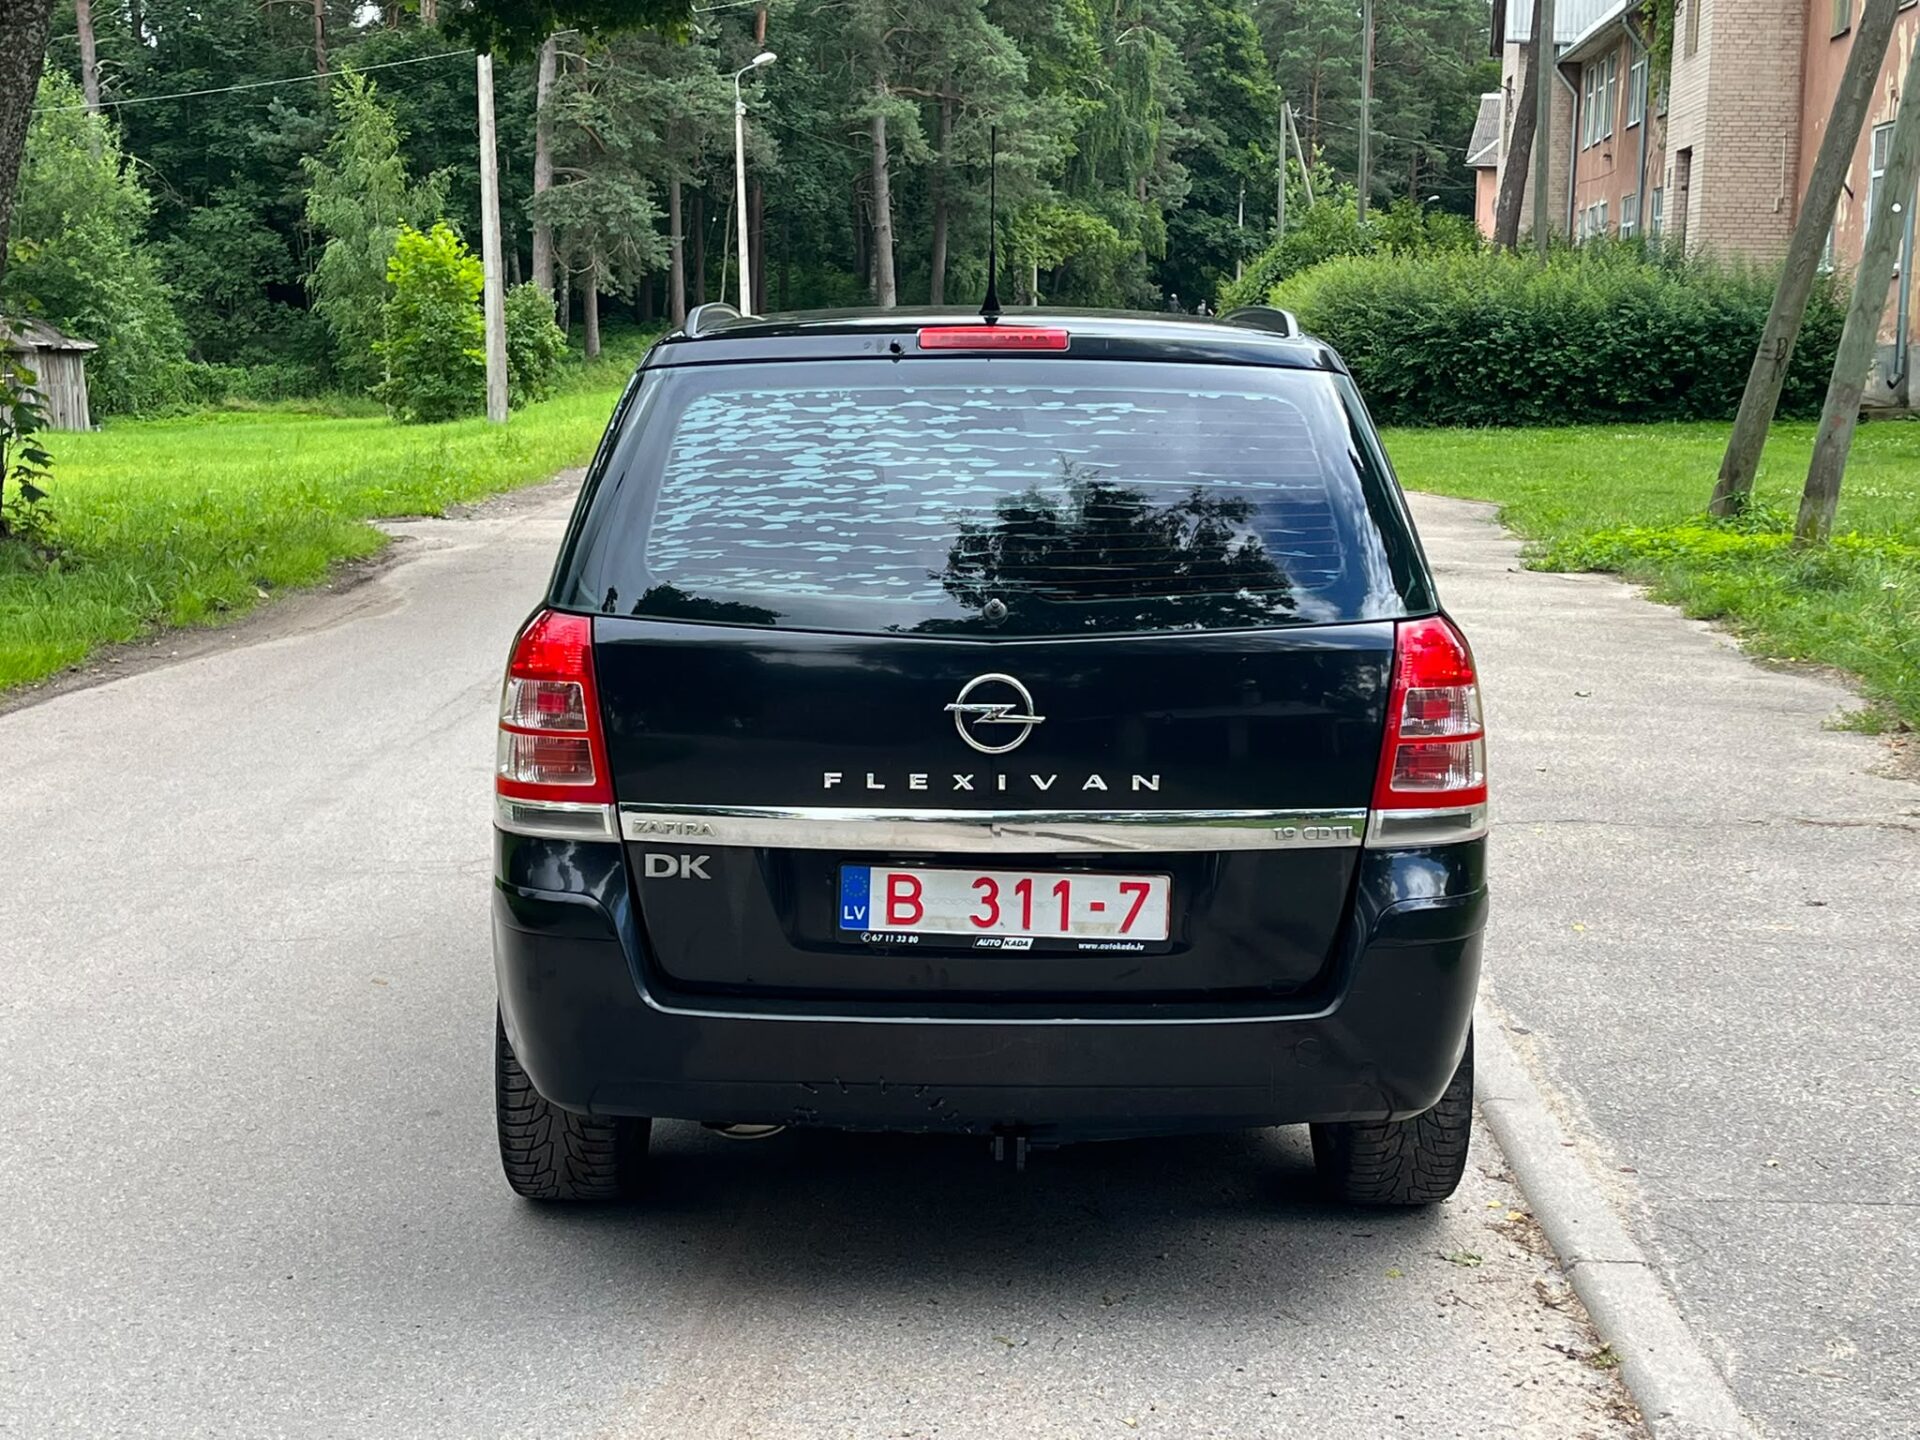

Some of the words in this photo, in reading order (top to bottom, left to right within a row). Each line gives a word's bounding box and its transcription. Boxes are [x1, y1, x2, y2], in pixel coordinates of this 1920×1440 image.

[823, 772, 1160, 790] FLEXIVAN
[632, 820, 716, 836] ZAFIRA
[1303, 825, 1353, 840] CDTI
[644, 853, 711, 879] DK
[886, 873, 924, 926] B
[970, 876, 1151, 933] 311-7
[843, 905, 866, 920] LV
[871, 933, 883, 942] 67
[885, 934, 894, 942] 11
[896, 935, 906, 943] 33
[976, 938, 1001, 947] AUTO
[1003, 939, 1030, 948] KADA
[1078, 942, 1145, 951] www.autokada.lv
